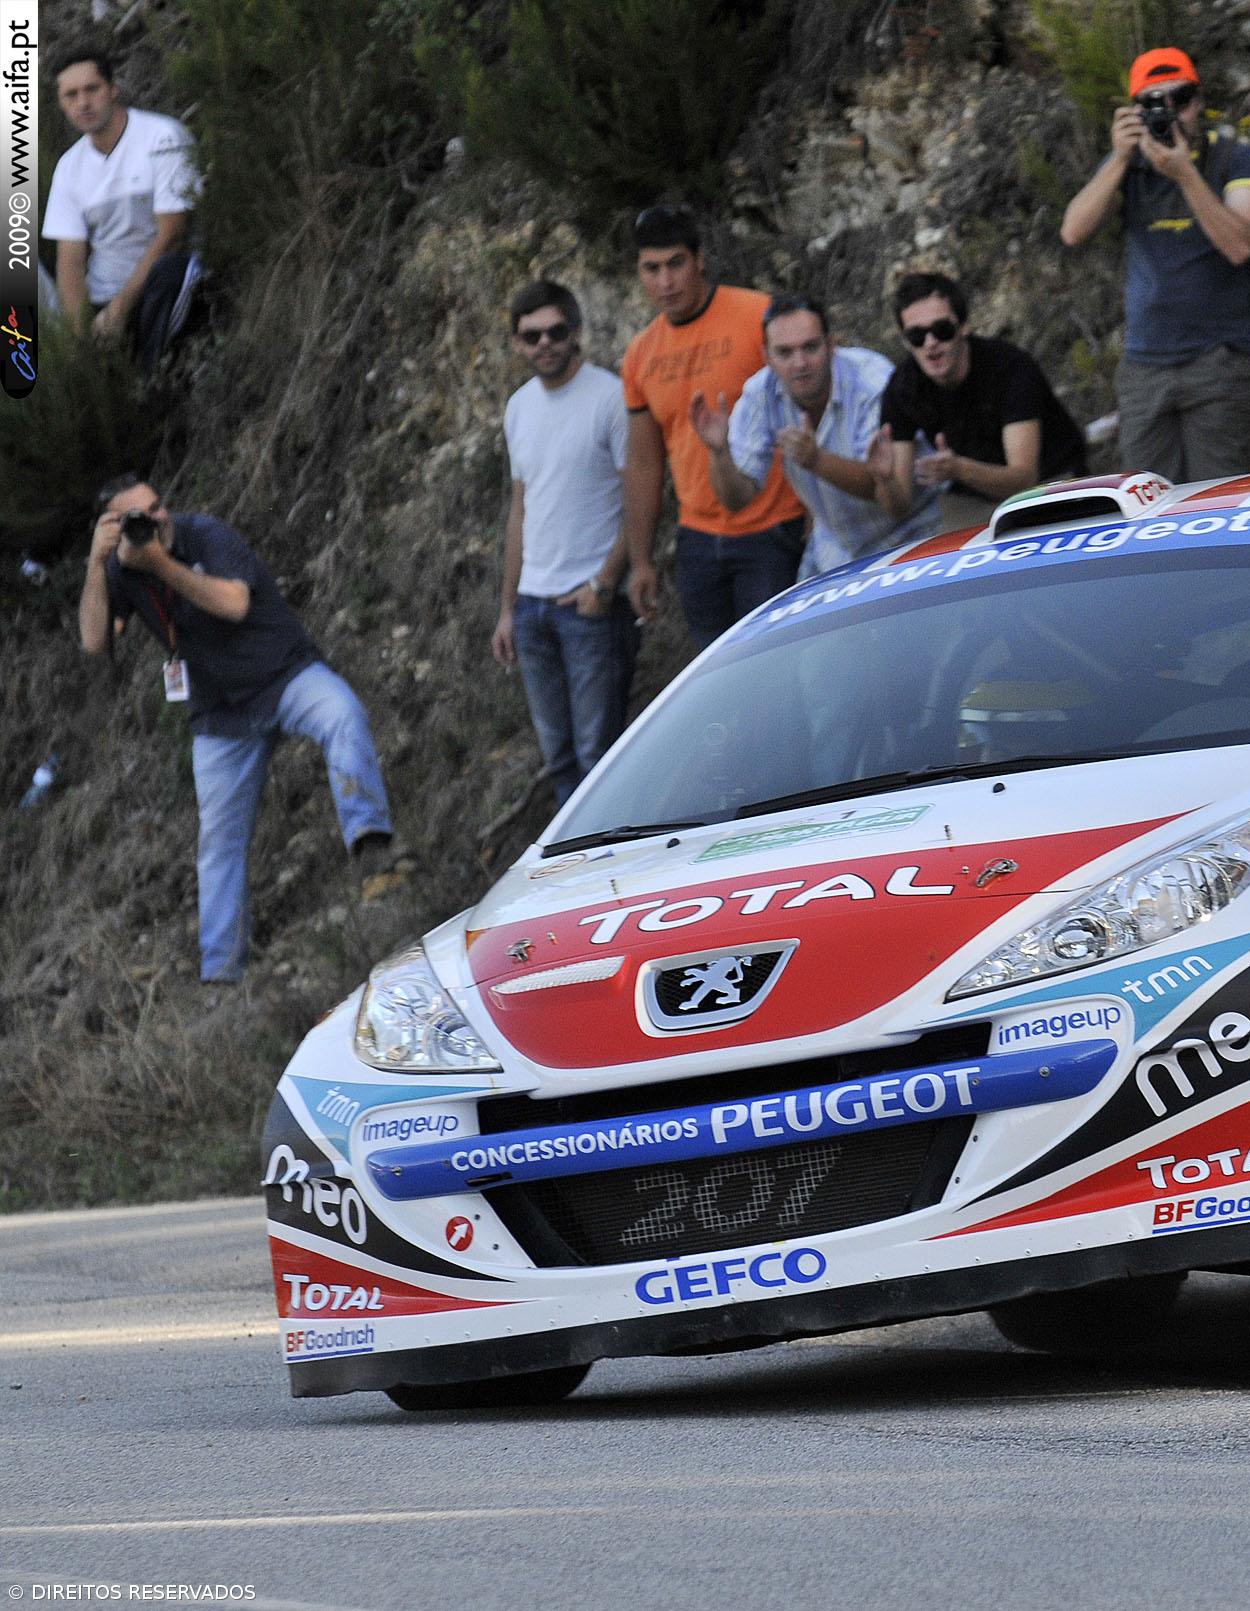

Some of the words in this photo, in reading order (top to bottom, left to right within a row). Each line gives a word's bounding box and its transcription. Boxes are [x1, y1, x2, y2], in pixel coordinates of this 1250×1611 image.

[579, 866, 955, 944] TOTAL
[1121, 953, 1214, 1004] tmn
[999, 1005, 1121, 1045] imageup
[316, 1086, 360, 1126] tmn
[363, 1114, 459, 1141] imageup
[450, 1117, 699, 1172] CONCESSIONÁRIOS
[711, 1066, 980, 1143] PEUGEOT
[261, 1144, 367, 1245] meo
[618, 1143, 842, 1247] 207
[282, 1273, 385, 1311] TOTAL
[635, 1247, 828, 1305] GEFCO
[286, 1323, 375, 1353] BFGoodrich
